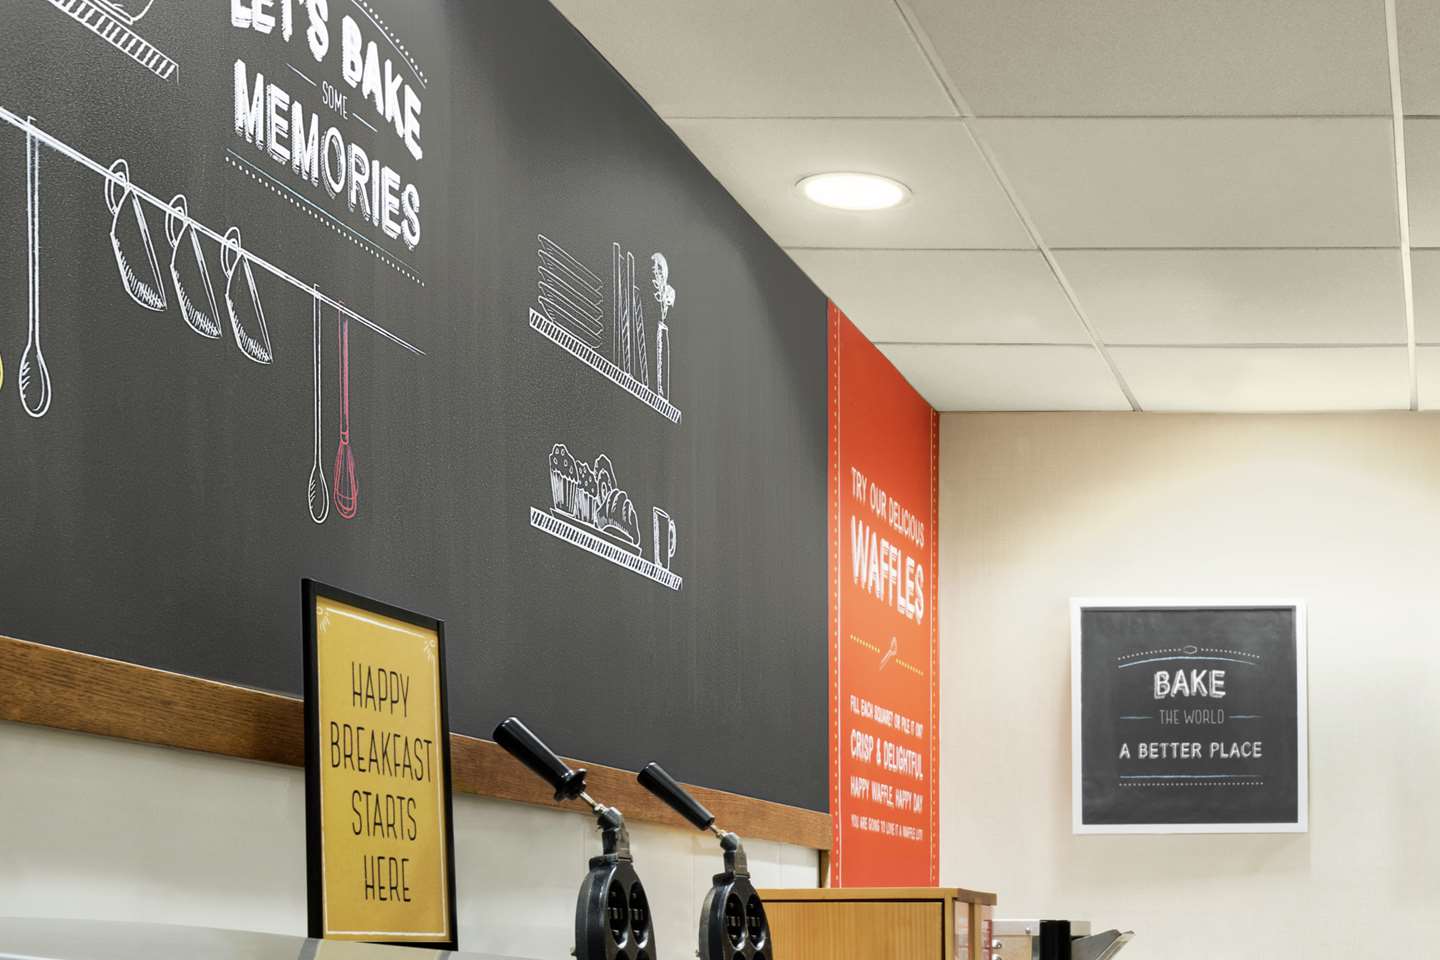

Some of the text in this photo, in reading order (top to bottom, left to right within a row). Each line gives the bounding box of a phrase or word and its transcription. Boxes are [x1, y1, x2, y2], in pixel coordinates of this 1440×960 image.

[231, 0, 422, 161] ETS BAKE
[322, 80, 348, 120] SOME
[234, 59, 421, 250] MEMORIES
[851, 466, 925, 549] TRY OUR DELICIOUS
[850, 514, 925, 625] WAFFLES
[351, 660, 410, 718] HAPPY
[1153, 668, 1227, 699] BAKE
[1159, 709, 1225, 725] THE WORLD
[330, 720, 433, 783] BREAKFAST
[850, 728, 874, 763] CRISP
[1118, 741, 1262, 759] A BETTER PLACE
[850, 776, 870, 800] HAPPY
[351, 789, 418, 841] STARTS
[363, 854, 412, 903] HERE
